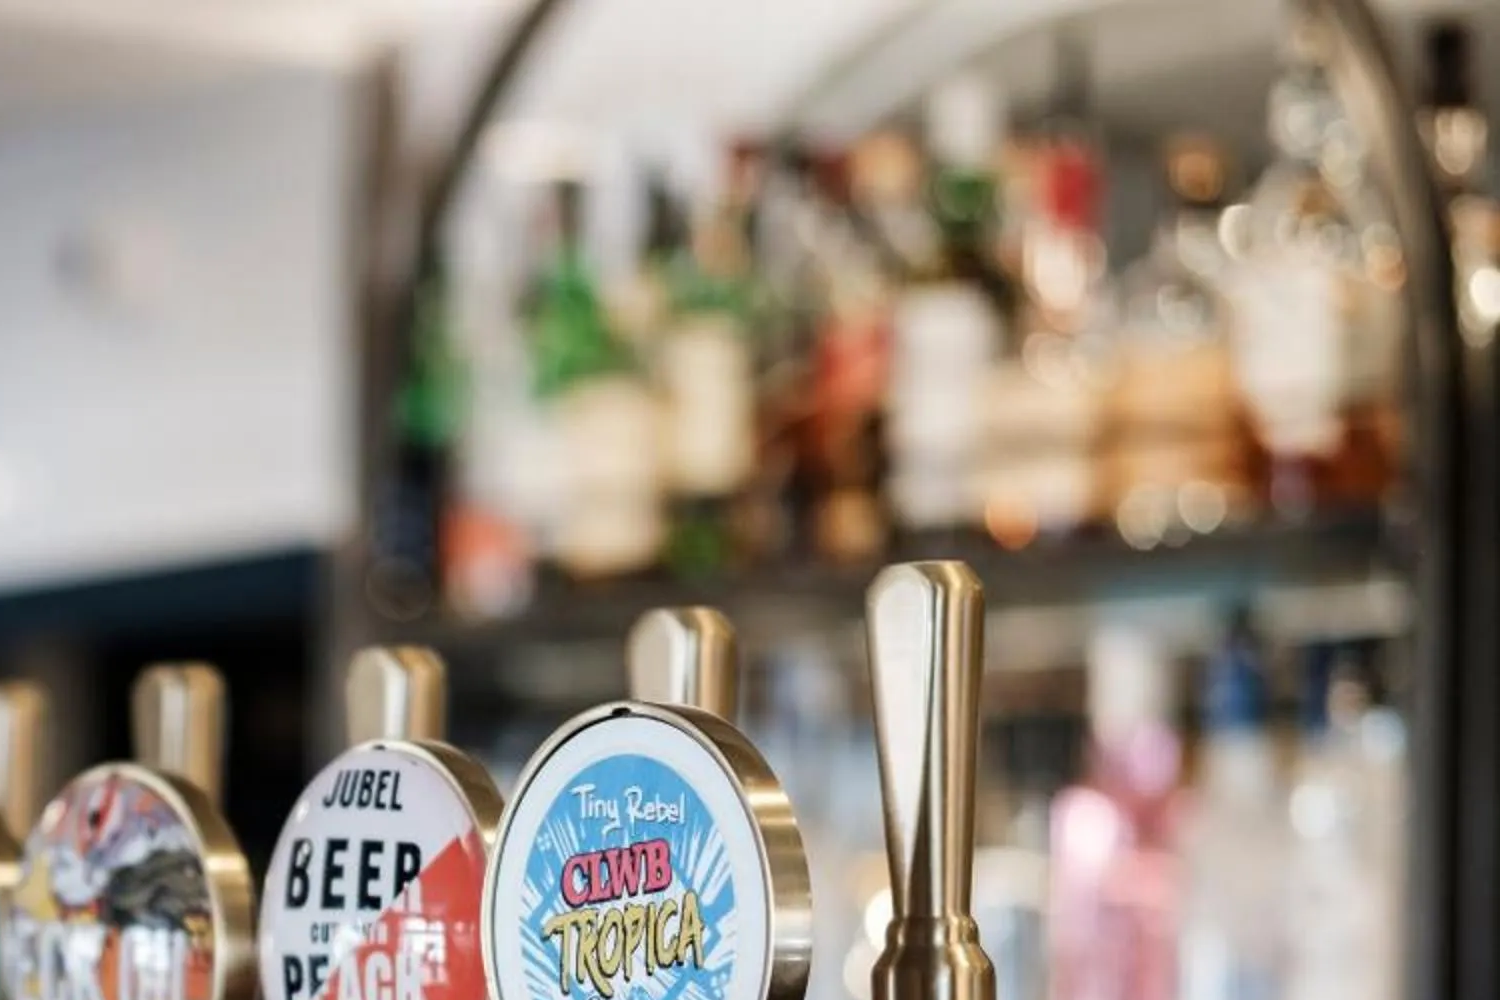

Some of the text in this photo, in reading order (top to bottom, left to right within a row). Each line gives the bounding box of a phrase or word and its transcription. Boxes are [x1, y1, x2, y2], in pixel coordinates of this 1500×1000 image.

[323, 769, 403, 811] JUBEL
[570, 783, 686, 834] Tiny Rebel
[284, 837, 422, 915] BEER
[561, 838, 673, 909] CLWB
[541, 888, 705, 1000] TROPICA
